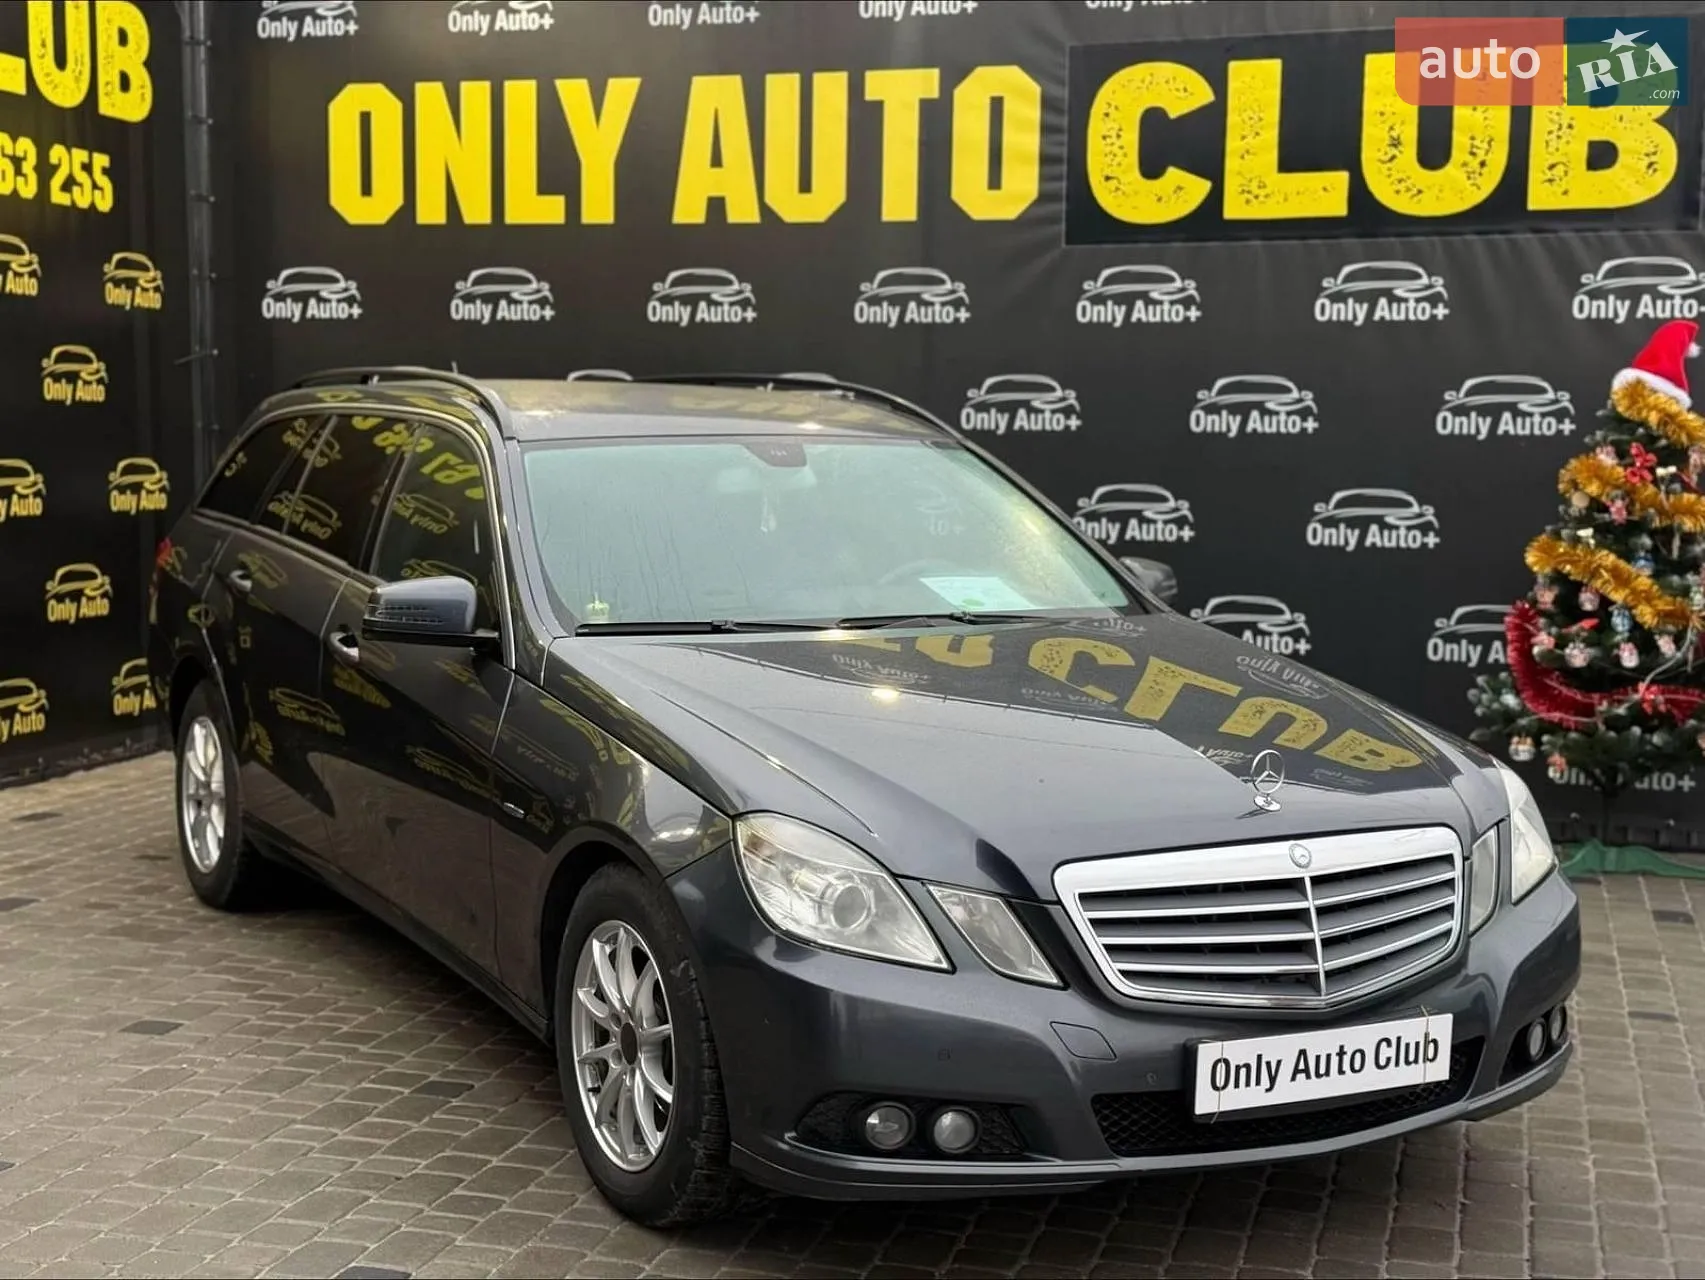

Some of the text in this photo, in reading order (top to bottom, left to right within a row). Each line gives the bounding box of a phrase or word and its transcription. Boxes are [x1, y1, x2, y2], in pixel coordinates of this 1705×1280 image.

[448, 8, 554, 36] Only Auto+
[648, 1, 760, 30] Only Auto+
[858, 0, 905, 22] Only
[257, 16, 359, 41] Only Auto+
[0, 0, 153, 122] UB
[327, 43, 1679, 226] ONLY AUTO CLUB
[49, 143, 114, 213] 255
[5, 270, 39, 297] Auto
[104, 282, 162, 311] Only Auto
[261, 297, 363, 323] Only Auto+
[450, 298, 555, 324] Only Auto+
[647, 301, 757, 327] Only Auto+
[853, 300, 971, 328] Only Auto+
[1075, 299, 1203, 328] Only Auto+
[1313, 297, 1449, 326] Only Auto+
[1572, 294, 1631, 324] Only
[43, 377, 106, 406] Only Auto
[960, 407, 1083, 435] Only Auto+
[1189, 409, 1320, 438] Only Auto+
[1435, 411, 1577, 440] Only Auto+
[10, 494, 43, 517] Auto
[109, 490, 168, 515] Only Auto
[1124, 517, 1195, 543] Auto+
[1306, 521, 1441, 552] Only Auto+
[47, 596, 110, 624] Only Auto
[1426, 637, 1483, 668] Only
[113, 693, 141, 716] Only
[12, 711, 46, 736] Auto
[1209, 1031, 1440, 1093] Only Auto Club
